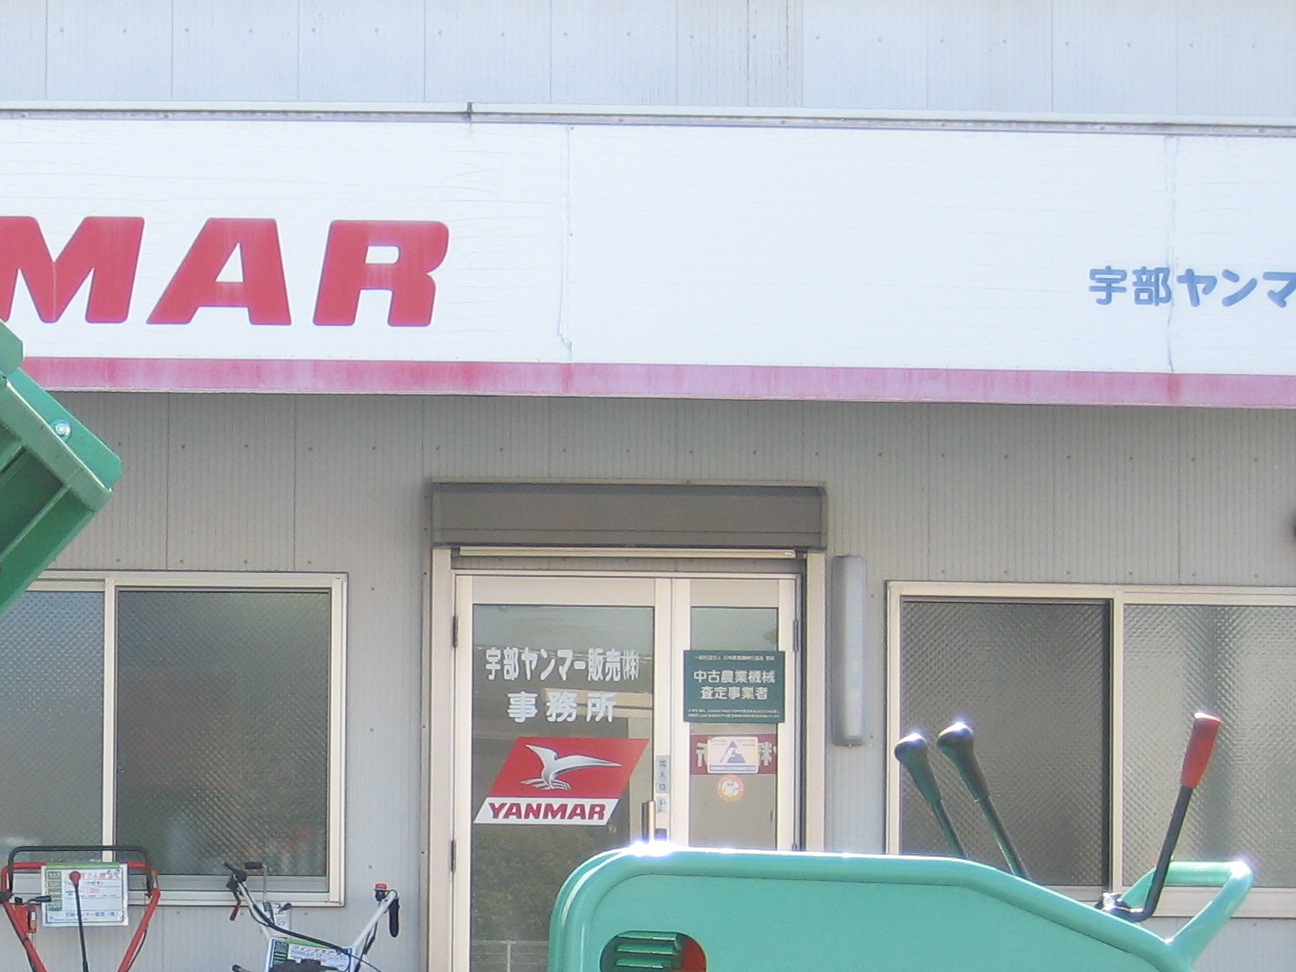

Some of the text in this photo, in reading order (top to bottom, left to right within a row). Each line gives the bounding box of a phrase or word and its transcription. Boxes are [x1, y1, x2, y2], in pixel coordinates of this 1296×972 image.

[693, 669, 776, 684] 中古農業機械
[700, 686, 769, 700] 査定事業者
[507, 691, 617, 723] 事務所
[488, 802, 607, 821] YANMAR
